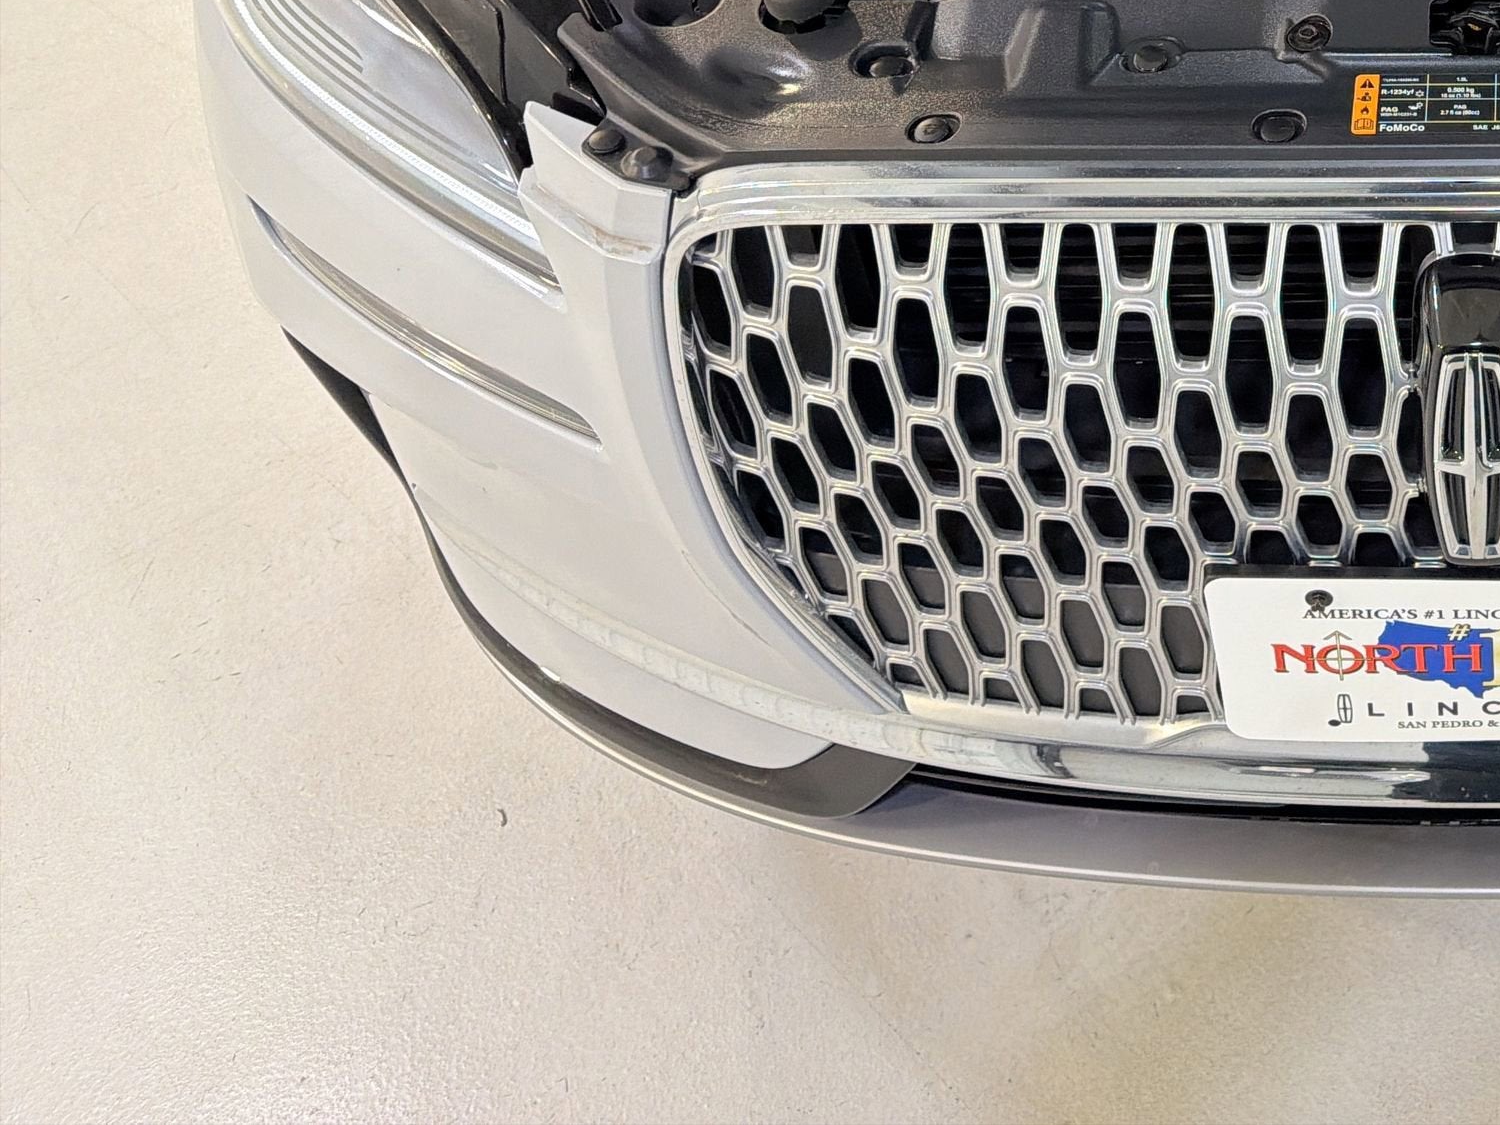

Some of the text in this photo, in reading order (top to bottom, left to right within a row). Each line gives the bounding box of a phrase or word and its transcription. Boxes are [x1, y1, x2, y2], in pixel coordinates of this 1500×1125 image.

[1380, 88, 1415, 96] R-1234yf
[1379, 124, 1425, 132] FoMoCo
[1302, 608, 1419, 620] AMERICA'S
[1424, 609, 1446, 620] #1
[1270, 642, 1483, 674] NORTH
[1397, 720, 1428, 729] SAN
[1431, 719, 1484, 729] PEDRO
[1487, 719, 1500, 728] &
